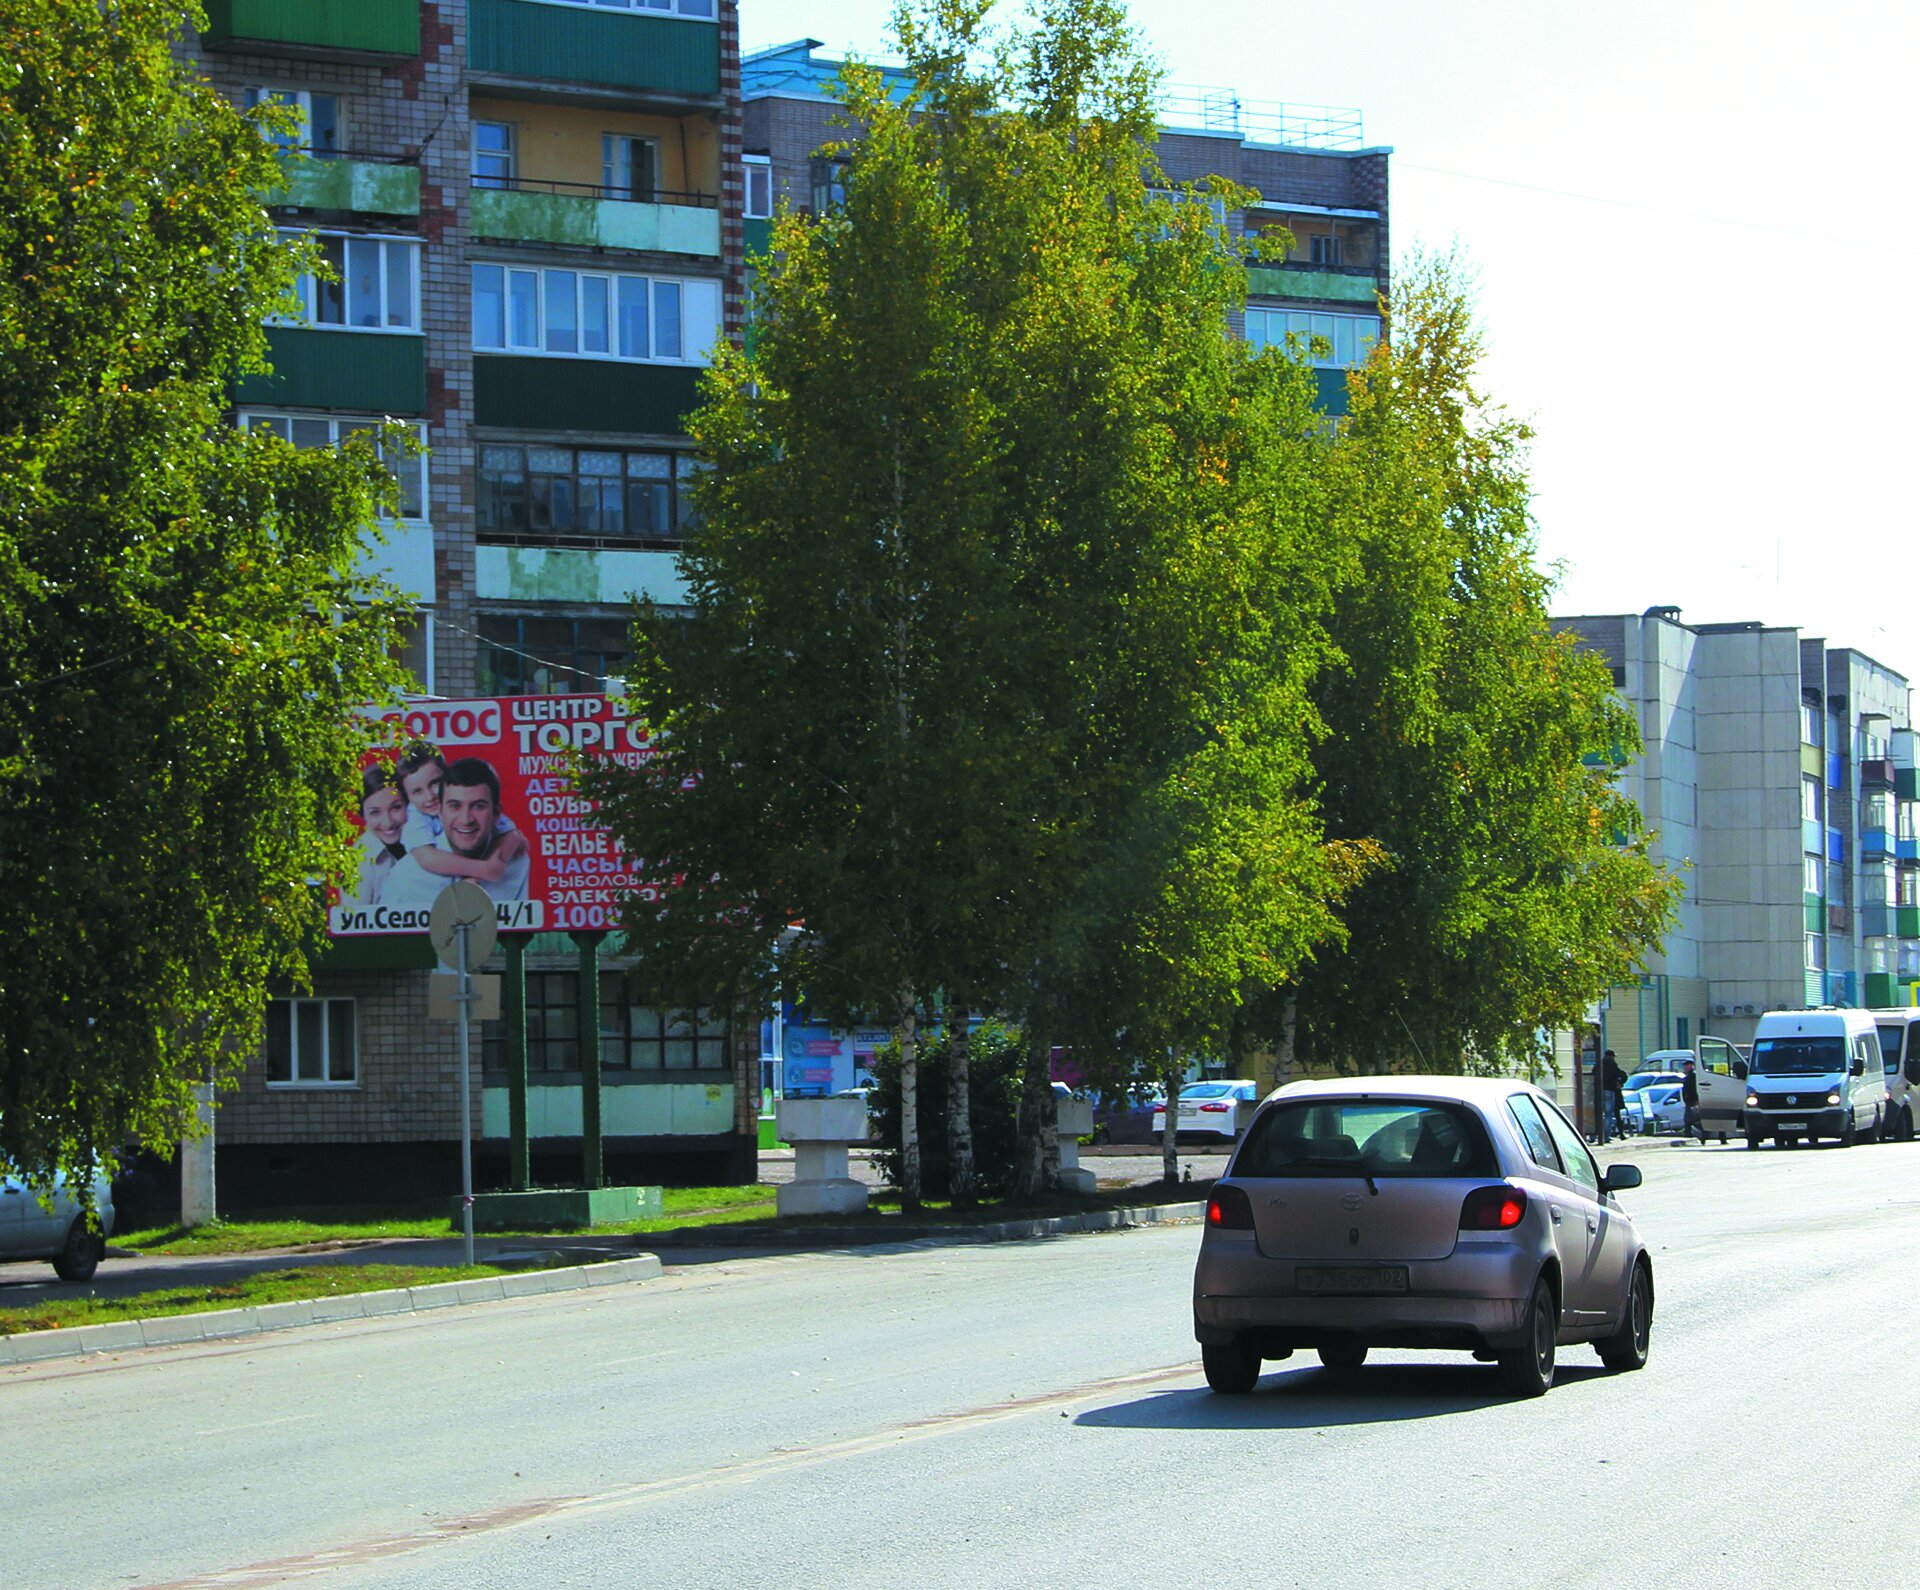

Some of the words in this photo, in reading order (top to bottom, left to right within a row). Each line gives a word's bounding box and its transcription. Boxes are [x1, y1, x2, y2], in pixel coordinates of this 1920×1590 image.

[512, 698, 603, 721] ЦЕНТР
[528, 795, 593, 816] ОБУВЬ
[541, 832, 609, 856] БЕЛЬЕ
[547, 857, 624, 874] ЧАСЫ
